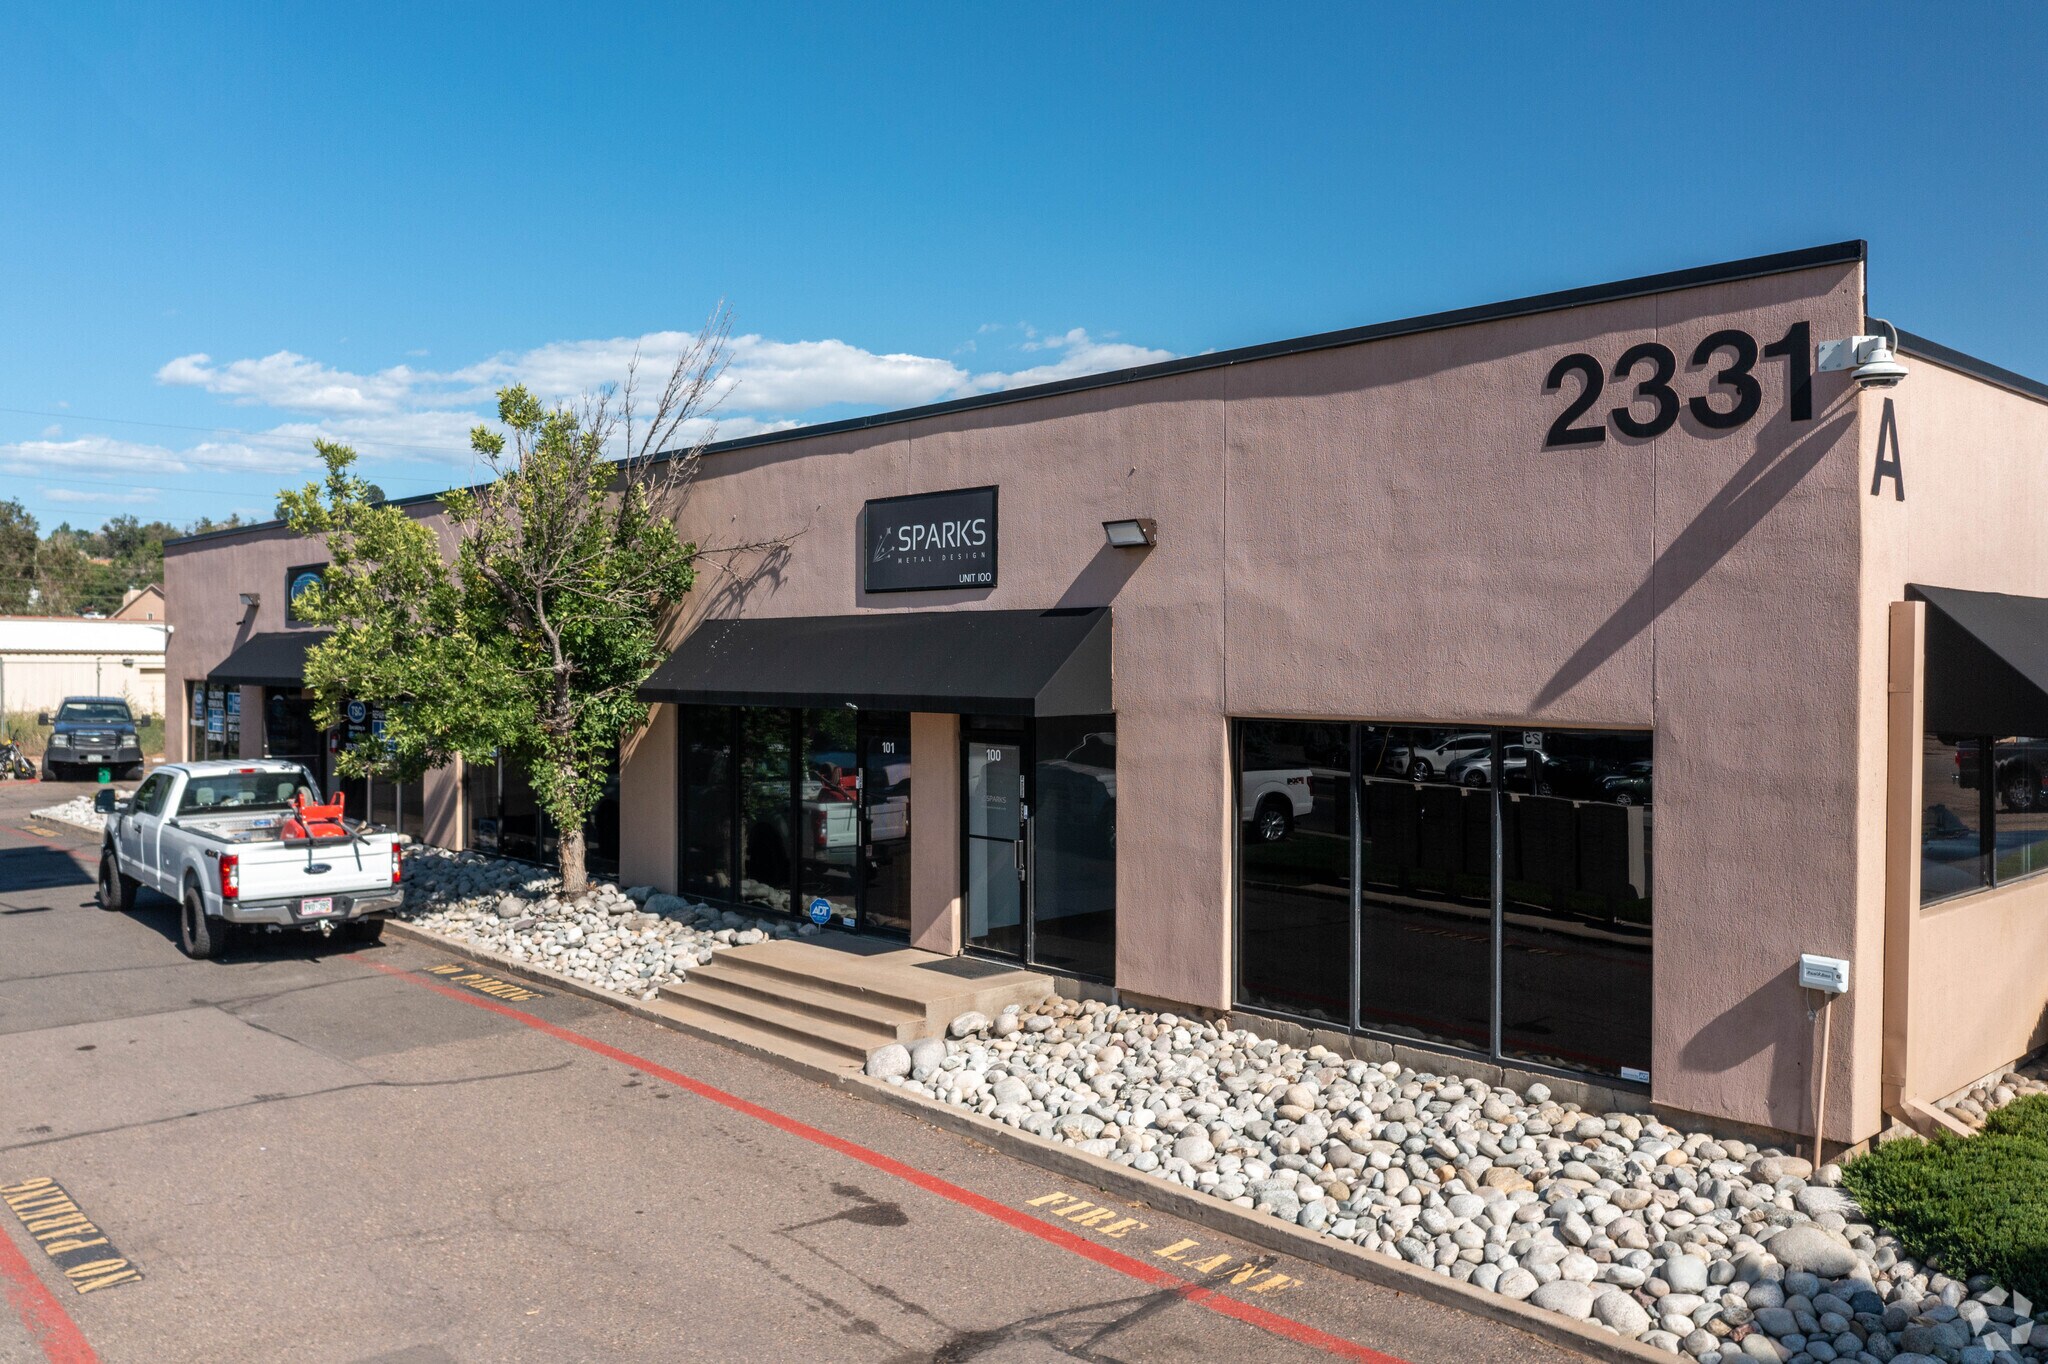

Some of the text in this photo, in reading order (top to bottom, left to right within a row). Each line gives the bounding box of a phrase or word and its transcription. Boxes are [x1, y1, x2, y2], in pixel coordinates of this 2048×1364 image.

[1546, 320, 1812, 447] 2331
[1871, 397, 1905, 502] A
[898, 518, 986, 552] SPARKS
[898, 552, 986, 564] METAL DESIGN
[959, 572, 992, 583] UNIT 100
[350, 705, 363, 716] TSC
[882, 741, 895, 754] 101
[986, 748, 1001, 762] 100
[986, 795, 1007, 804] SPARKS
[811, 906, 830, 916] ADT
[422, 964, 545, 1002] NO PARKING
[1025, 1191, 1304, 1295] FIRE LANE
